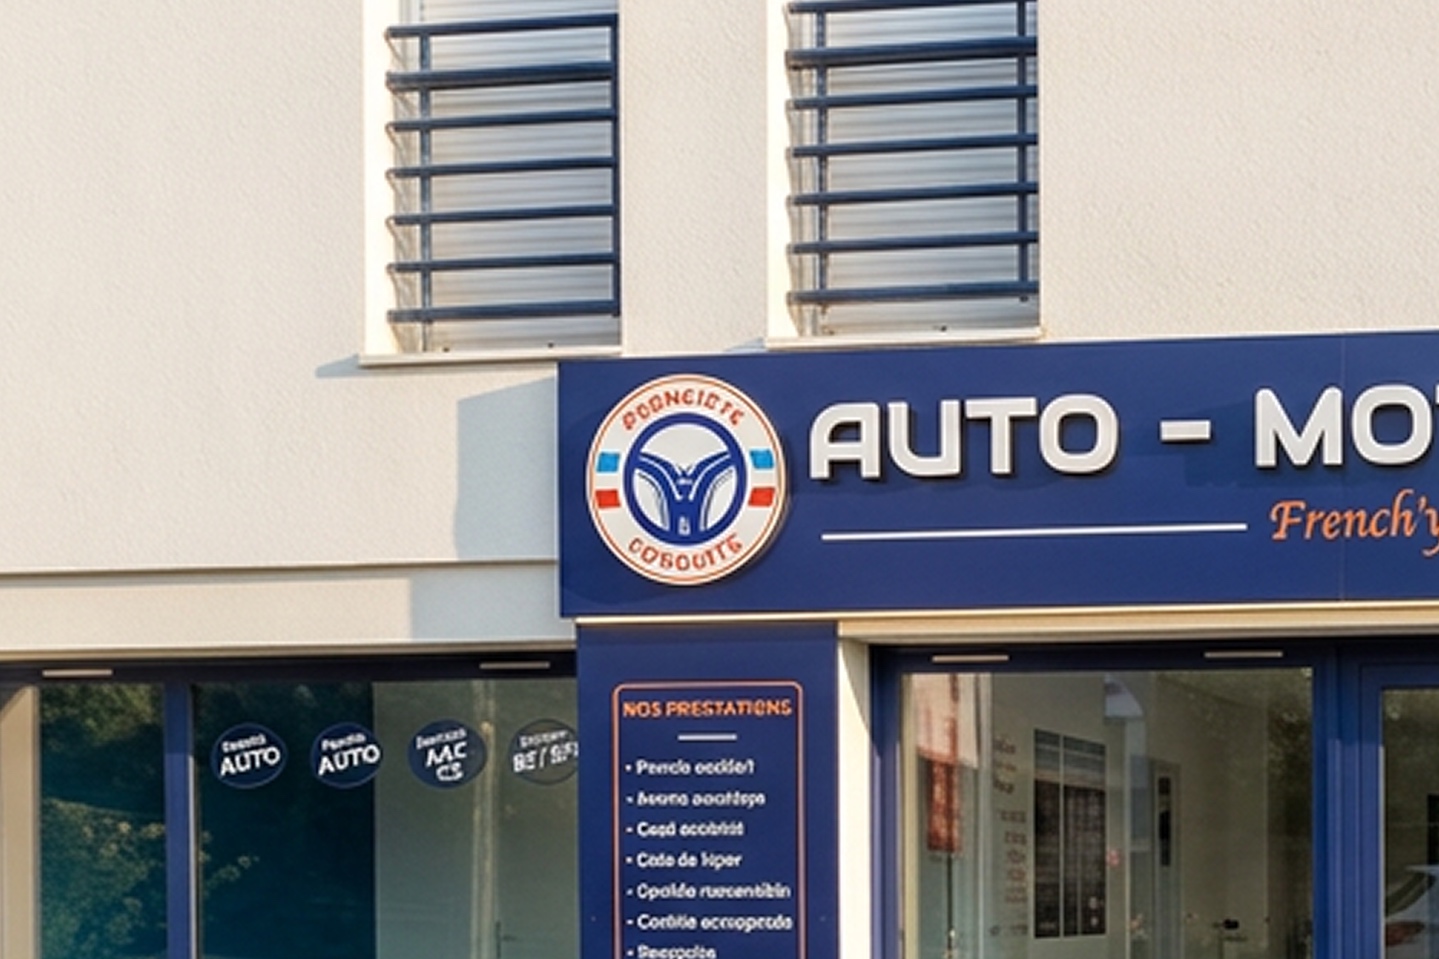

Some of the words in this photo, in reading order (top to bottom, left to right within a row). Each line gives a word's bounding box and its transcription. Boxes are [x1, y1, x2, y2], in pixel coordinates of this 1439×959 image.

[809, 394, 1119, 480] AUTO
[622, 700, 663, 718] NOS
[220, 746, 281, 777] AUTO
[318, 743, 381, 777] AUTO
